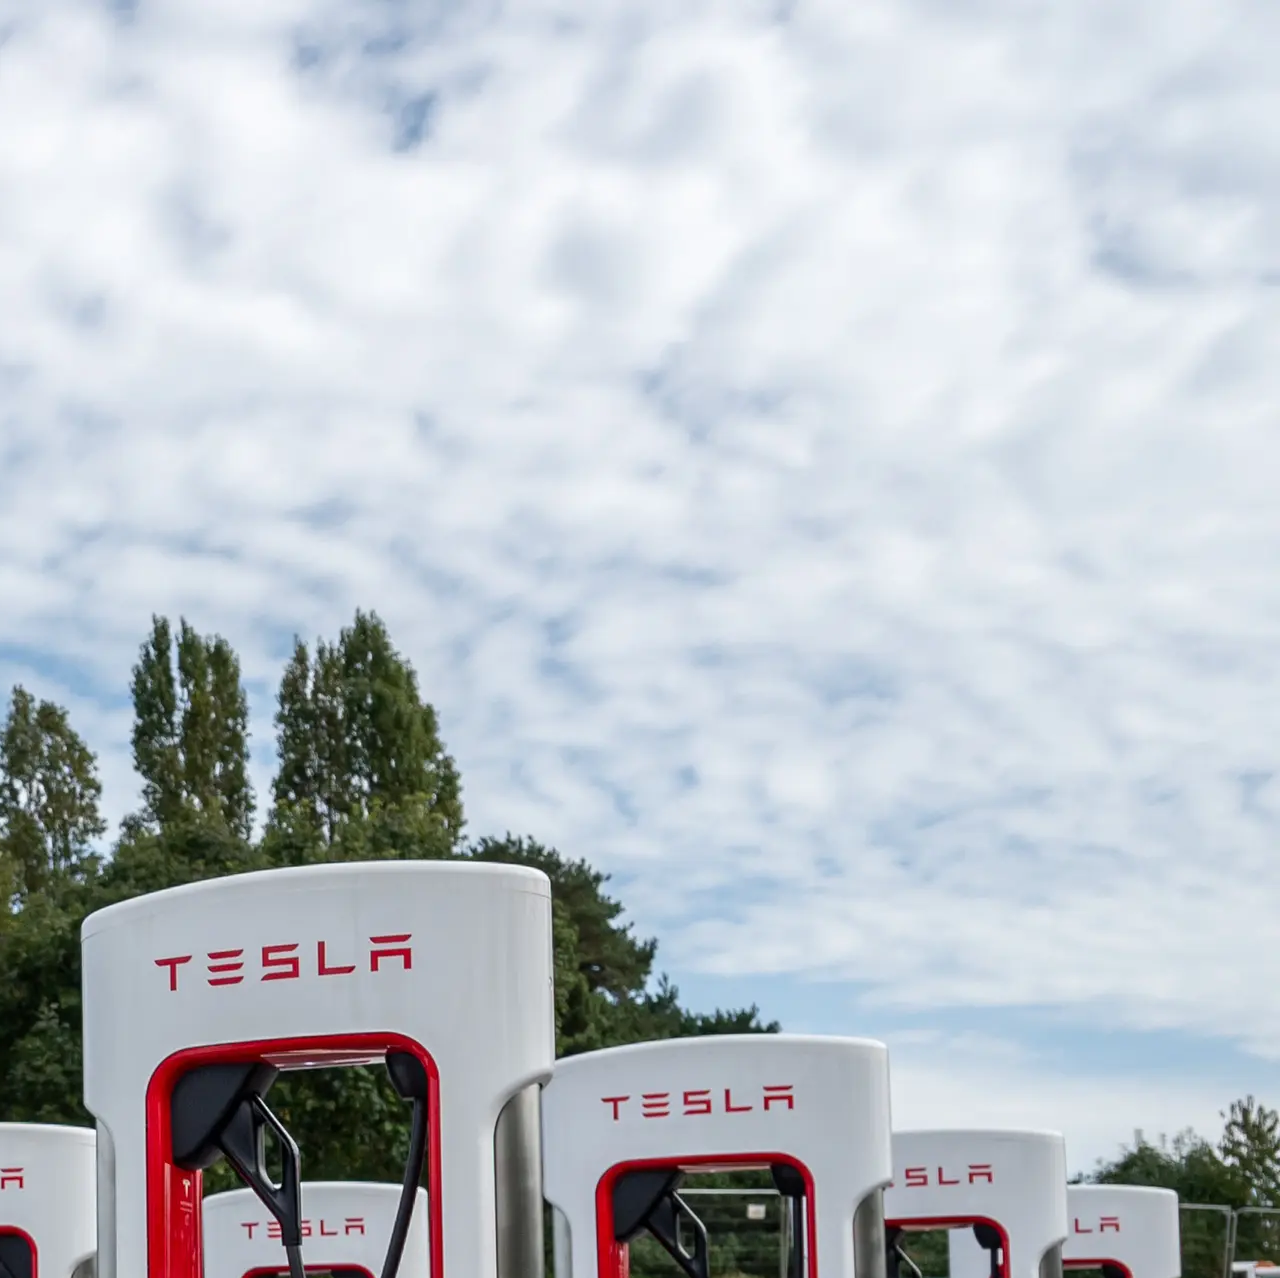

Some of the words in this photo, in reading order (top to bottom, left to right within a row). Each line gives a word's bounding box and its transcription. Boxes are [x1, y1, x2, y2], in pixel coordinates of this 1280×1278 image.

[154, 934, 412, 991] TESLA
[601, 1085, 794, 1121] TESLA
[890, 1164, 993, 1188] SLA
